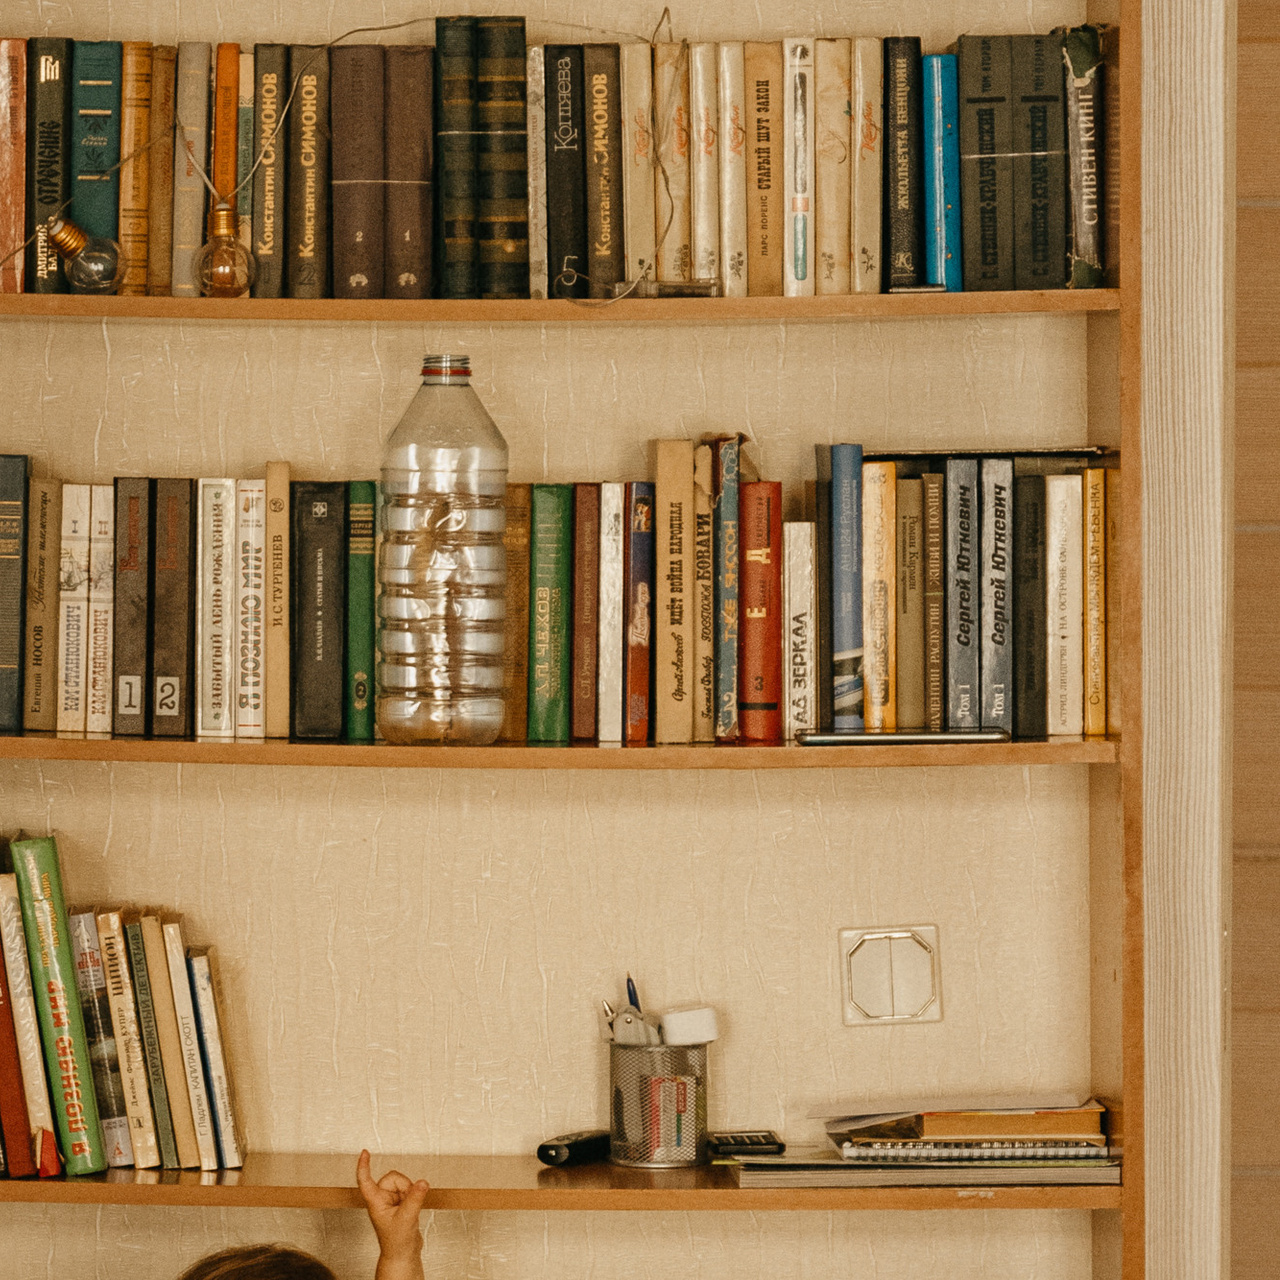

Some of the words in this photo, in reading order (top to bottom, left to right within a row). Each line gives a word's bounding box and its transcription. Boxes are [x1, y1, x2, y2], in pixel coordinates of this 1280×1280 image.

[555, 57, 577, 151] Коптяева
[757, 79, 770, 111] ЗАКОН
[1078, 87, 1095, 144] КИНГ
[758, 116, 770, 141] ШУТ
[755, 146, 770, 189] СТАРЫЙ
[1082, 150, 1098, 224] СТИВЕН
[212, 504, 223, 584] РОЖДЕНИЯ
[697, 513, 711, 581] БОВАРИ
[957, 486, 970, 572] Юткевич
[241, 541, 262, 588] МИР
[212, 588, 223, 628] ДЕНЬ
[955, 582, 973, 646] Сергей
[33, 625, 43, 666] НОСОВ
[240, 594, 261, 686] ПОЗНАЮ
[125, 682, 136, 708] 1
[210, 635, 223, 708] ЗАБЫТЫЙ
[238, 692, 260, 709] Я
[105, 935, 122, 996] ШПИОН
